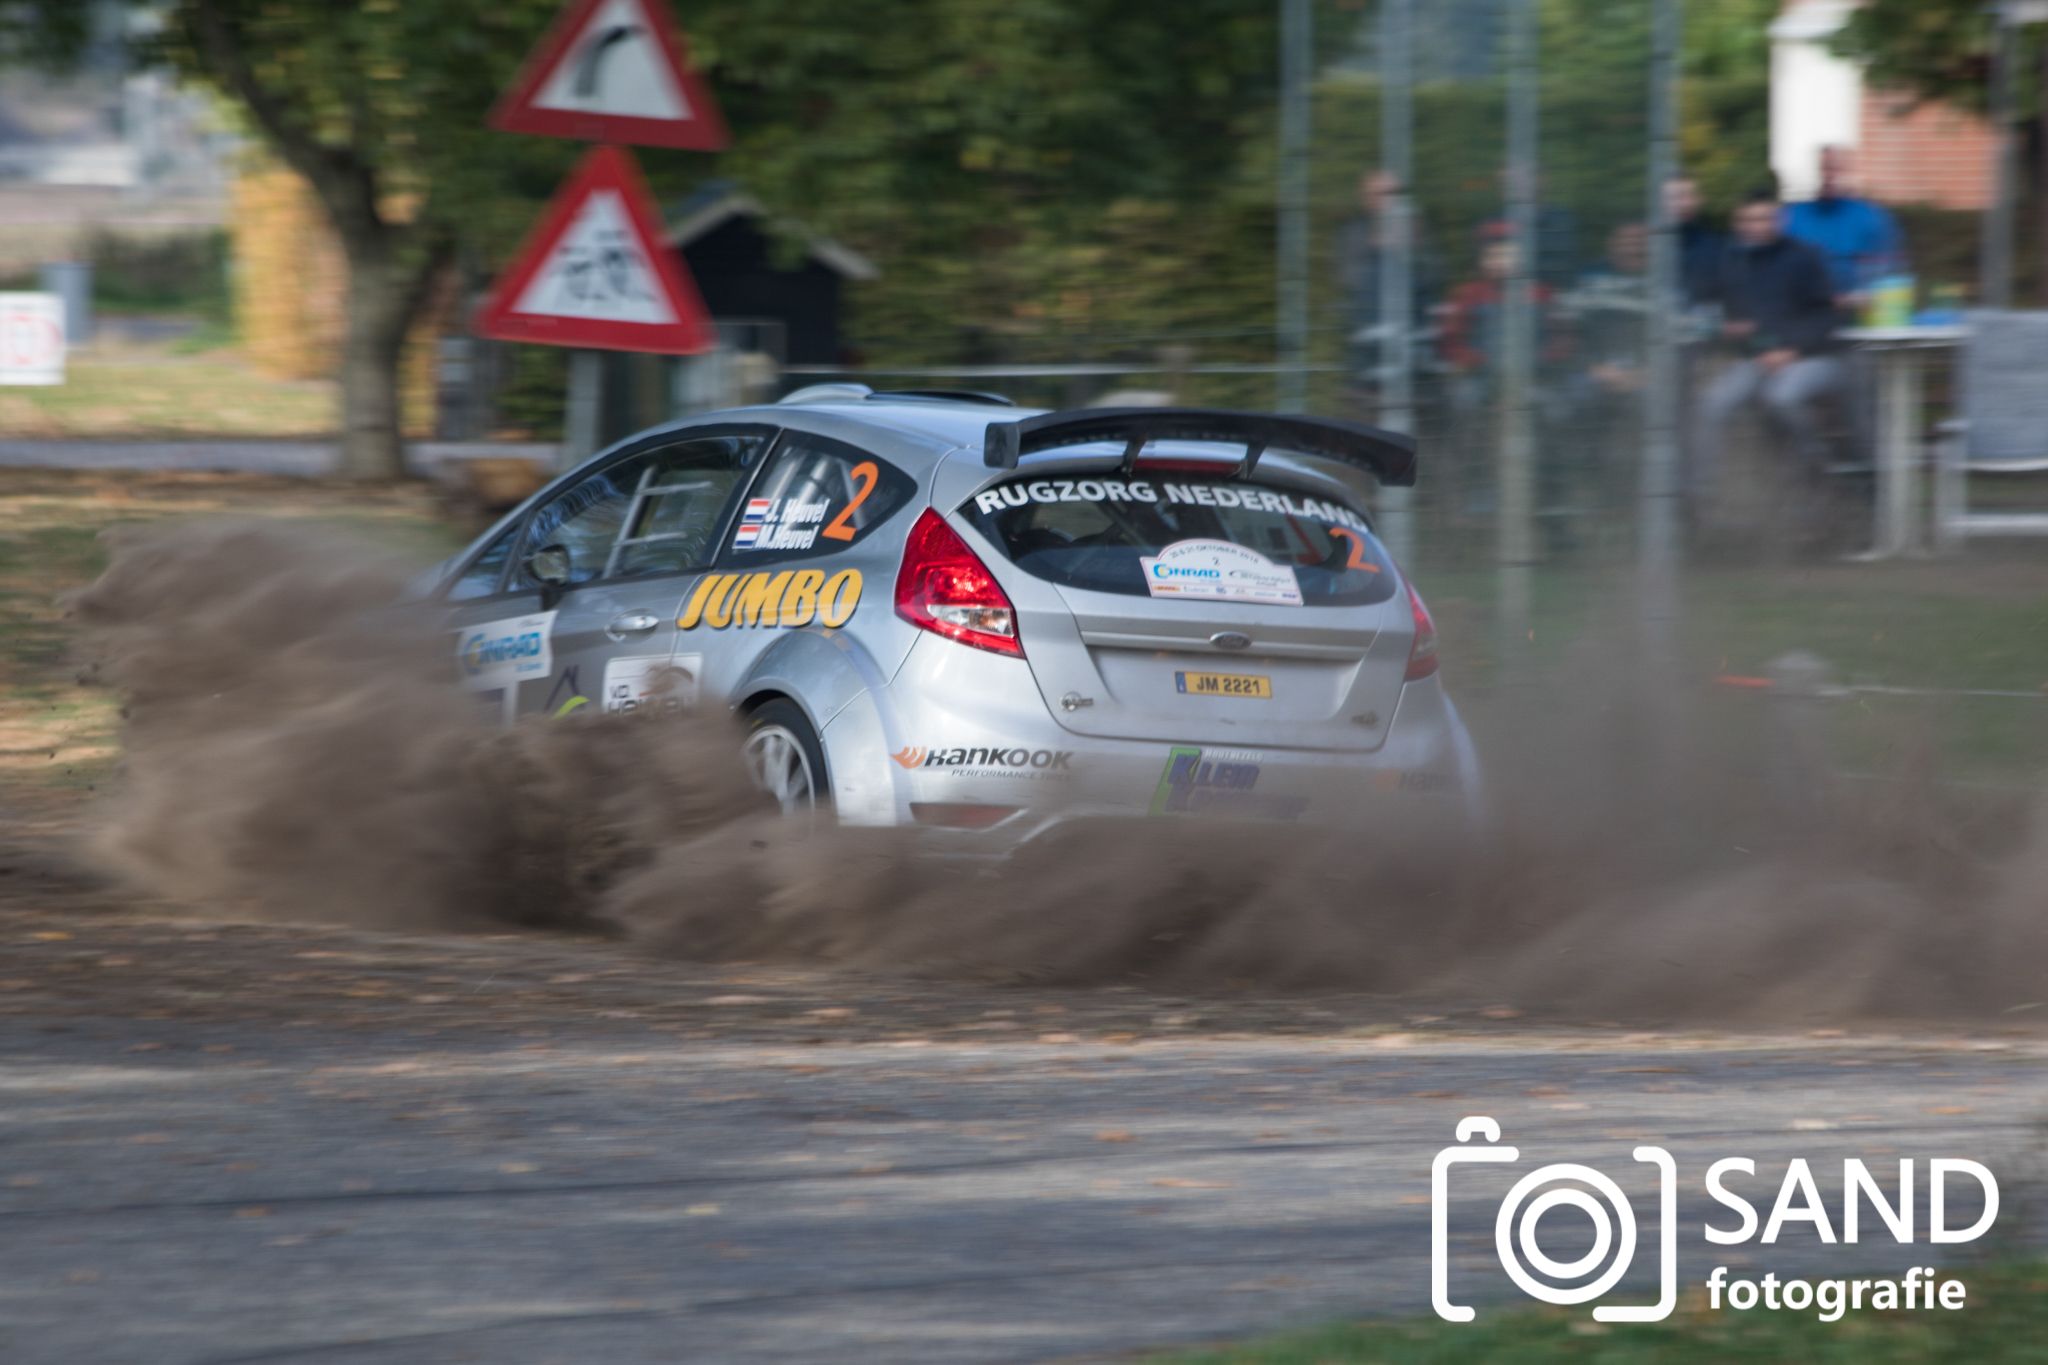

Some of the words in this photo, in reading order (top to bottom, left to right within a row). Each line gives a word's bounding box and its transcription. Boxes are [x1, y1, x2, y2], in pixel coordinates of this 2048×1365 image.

[822, 461, 879, 541] 2
[975, 481, 1157, 515] RUGZORG
[1163, 483, 1368, 533] NEDERLAND
[1329, 527, 1381, 573] 2
[676, 568, 864, 630] JUMBO
[1196, 676, 1219, 692] JM
[1223, 677, 1261, 694] 2221
